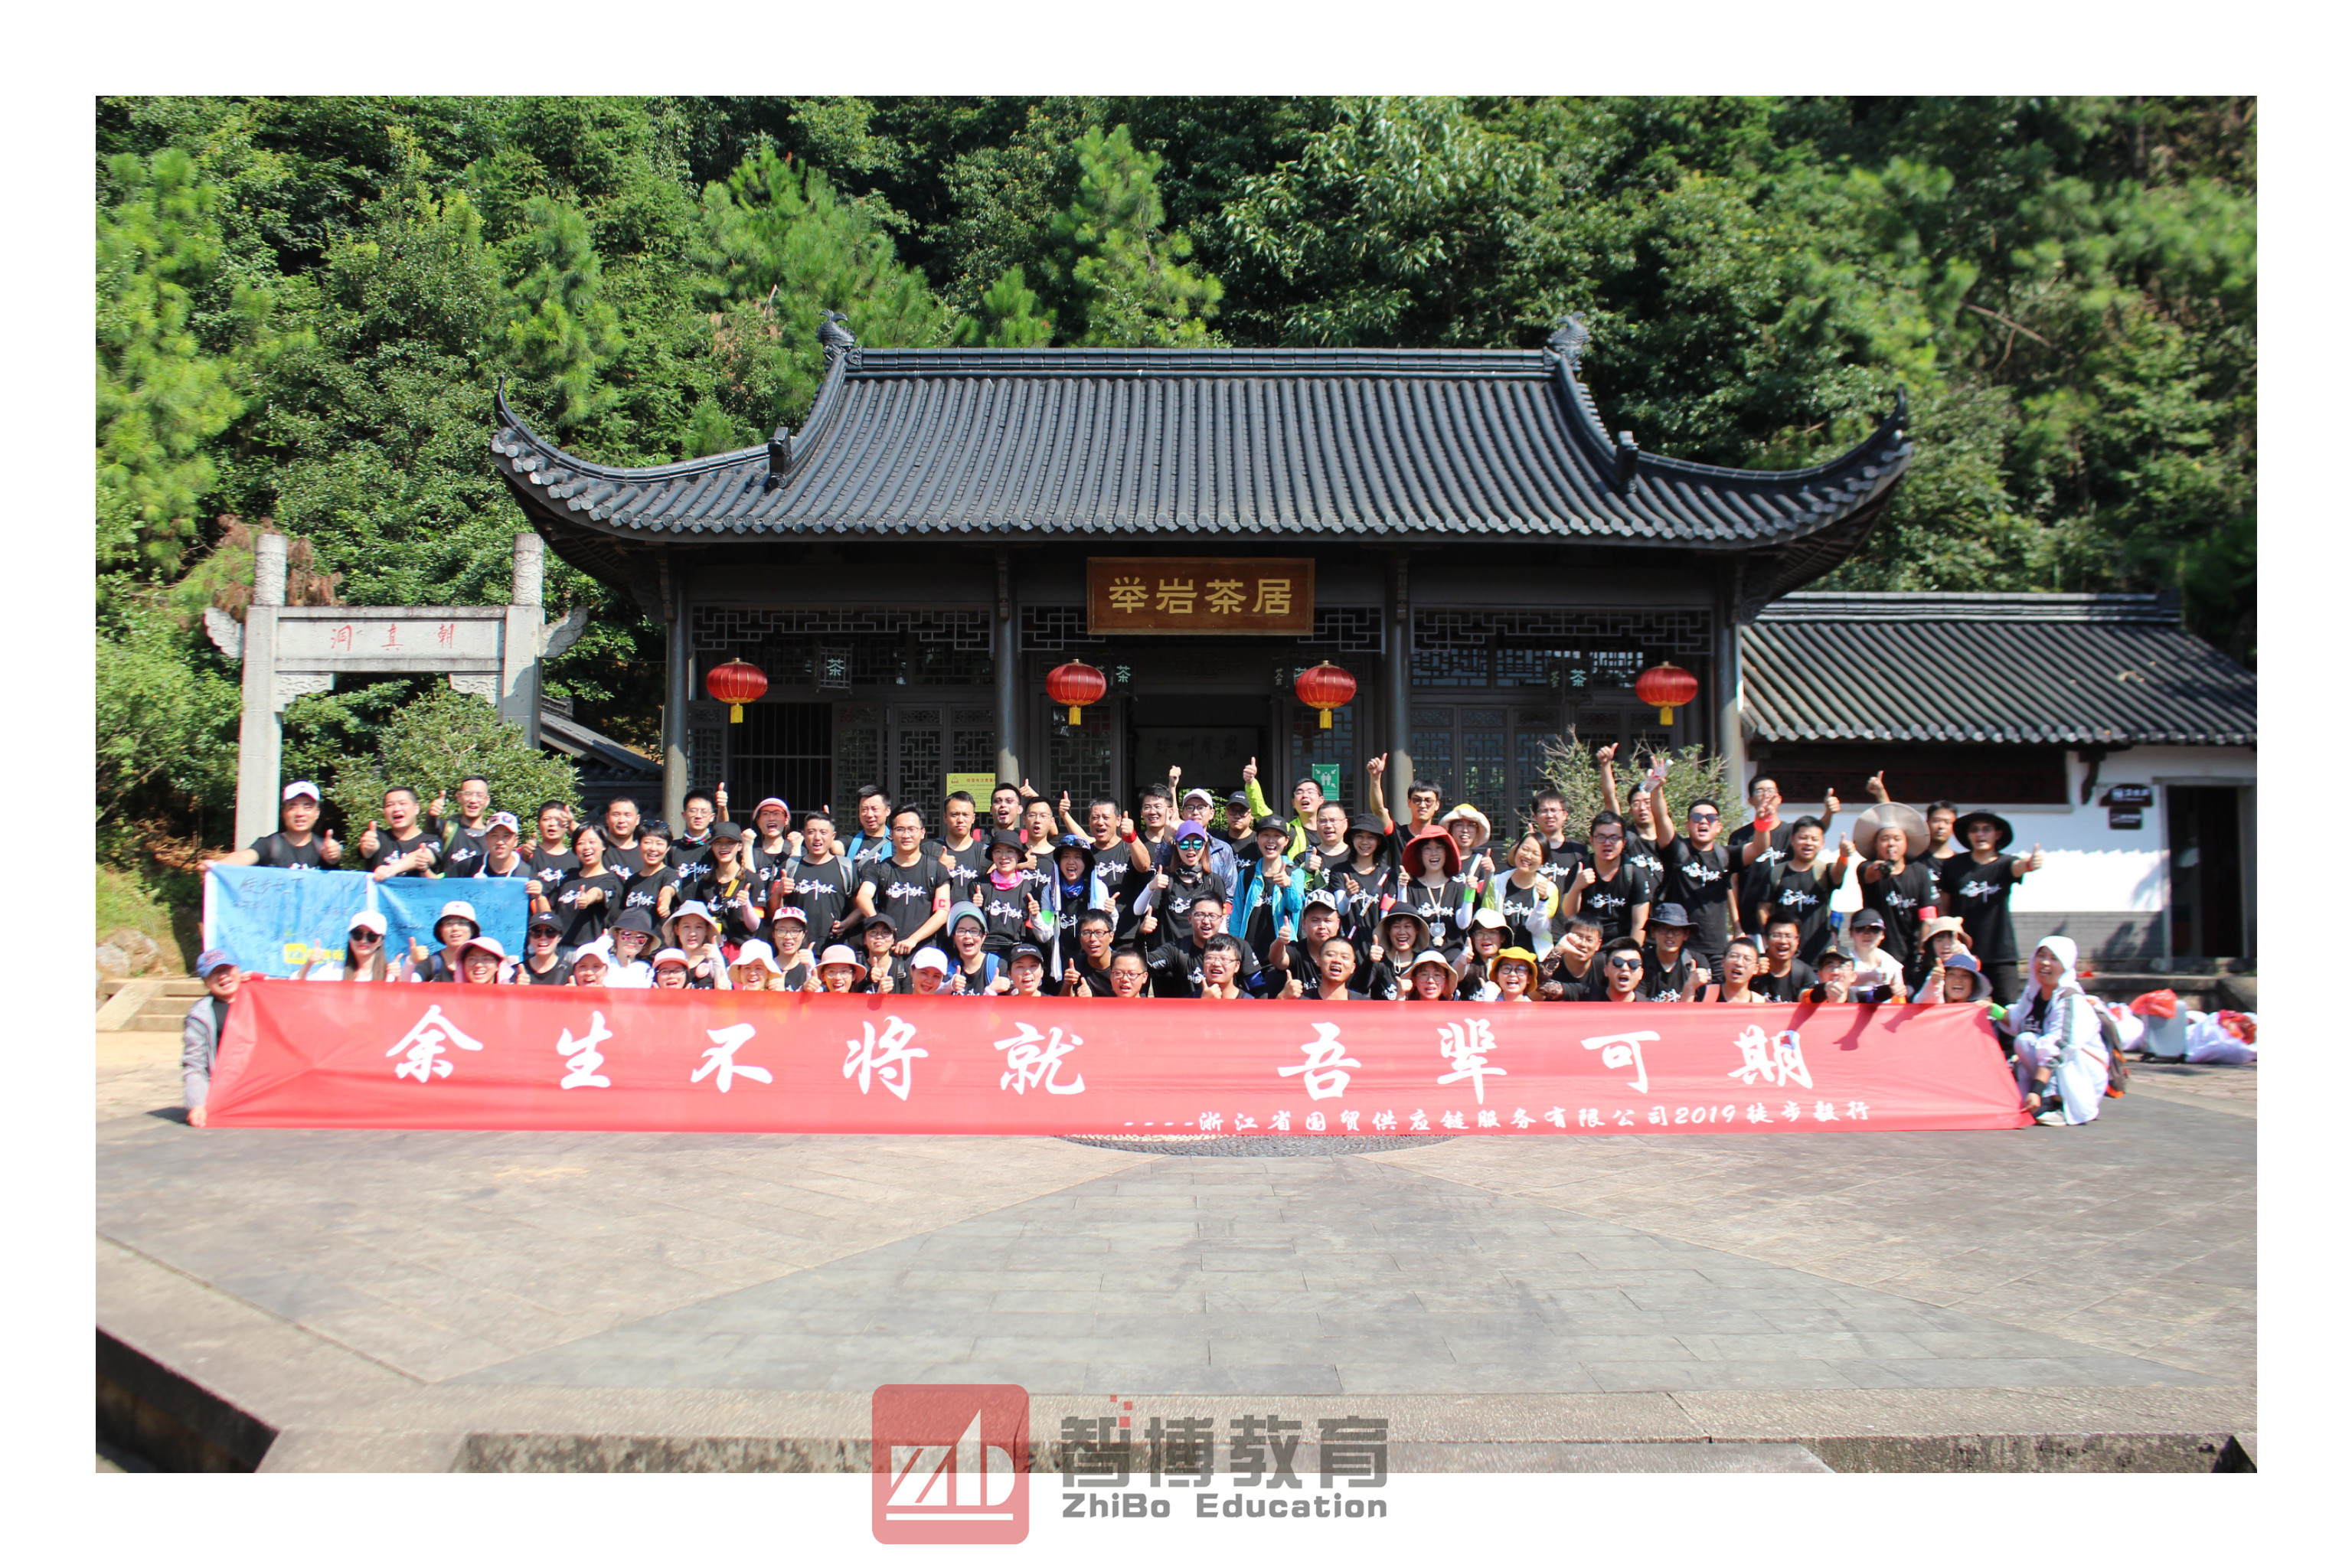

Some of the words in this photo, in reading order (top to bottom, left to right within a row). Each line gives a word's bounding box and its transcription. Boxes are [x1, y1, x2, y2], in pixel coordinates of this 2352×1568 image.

[1108, 577, 1292, 614] 举岩茶居
[826, 658, 845, 676] 茶
[1116, 665, 1132, 683] 茶
[1569, 669, 1587, 687] 茶
[938, 899, 946, 908] C
[1307, 890, 1332, 905] NYC
[780, 906, 803, 916] NYC
[385, 1004, 1086, 1101] 余生不将就
[1277, 1018, 1815, 1105] 吾辈可期
